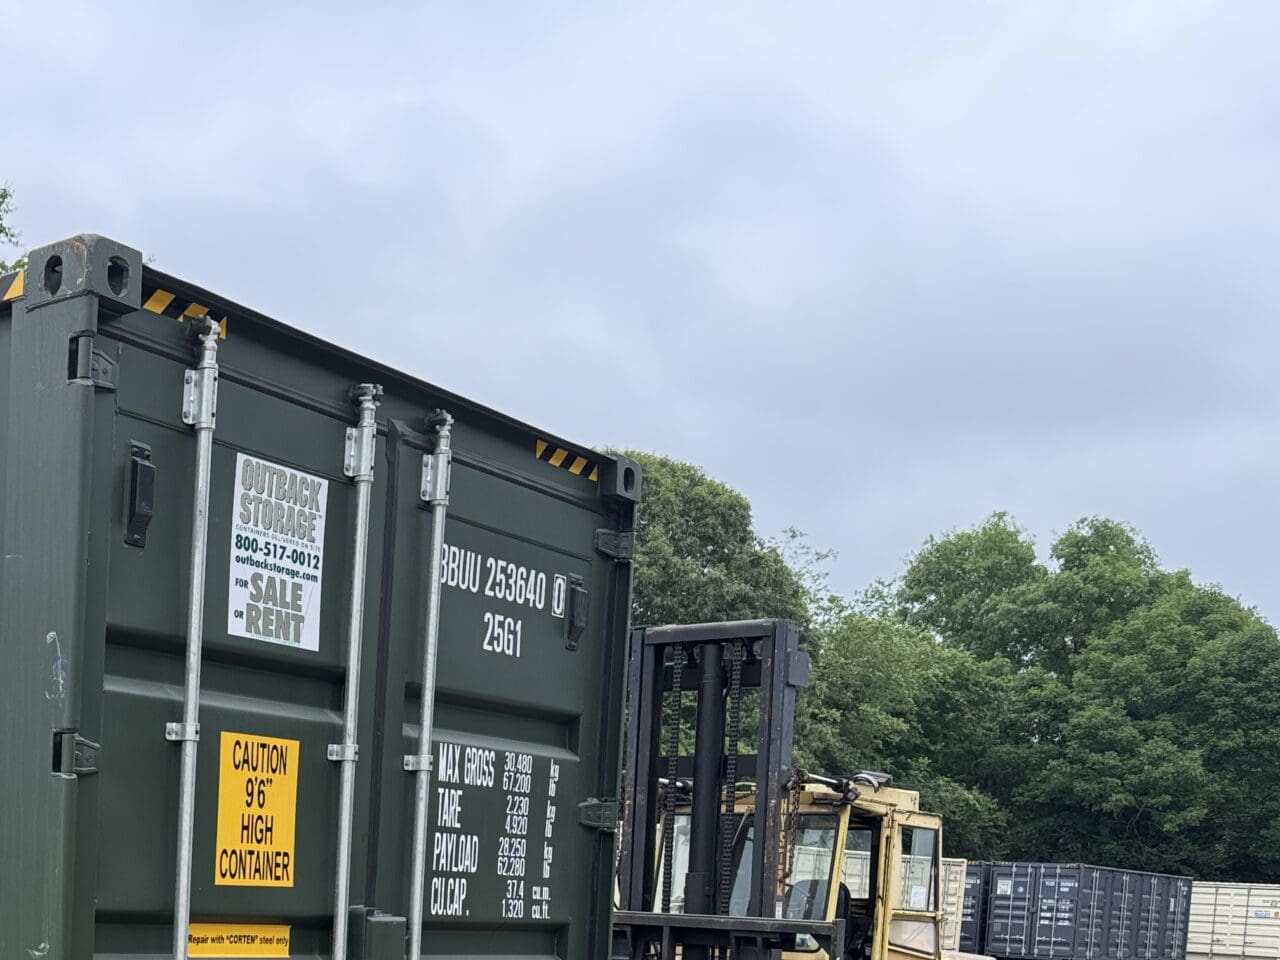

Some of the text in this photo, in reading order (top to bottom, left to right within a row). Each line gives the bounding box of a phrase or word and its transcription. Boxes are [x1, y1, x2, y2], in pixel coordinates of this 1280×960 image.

[241, 458, 322, 513] OUTBACK
[236, 523, 270, 538] CONTAINERS
[239, 491, 317, 544] STORAGE
[235, 534, 320, 570] 800-517-0012
[235, 554, 318, 583] outbackstorage.com
[235, 571, 303, 613] FOR SALE
[484, 556, 546, 610] 253640
[553, 577, 565, 615] 0
[234, 602, 305, 644] OR RENT
[483, 612, 522, 657] 25G1
[232, 739, 288, 776] CAUTION
[438, 743, 462, 783] MAX
[464, 747, 496, 788] GROSS
[549, 759, 560, 782] kg
[548, 777, 556, 797] lb
[437, 787, 463, 828] TARE
[546, 800, 556, 822] kg
[240, 813, 274, 845] HIGH
[545, 818, 553, 837] lb
[219, 848, 290, 882] CONTAINER
[432, 832, 479, 873] PAYLOAD
[543, 841, 553, 863] kg
[542, 859, 550, 878] lb
[506, 880, 524, 899] 37.4
[188, 934, 209, 946] Repair
[210, 934, 225, 944] with
[259, 935, 275, 944] steel
[276, 935, 289, 947] only
